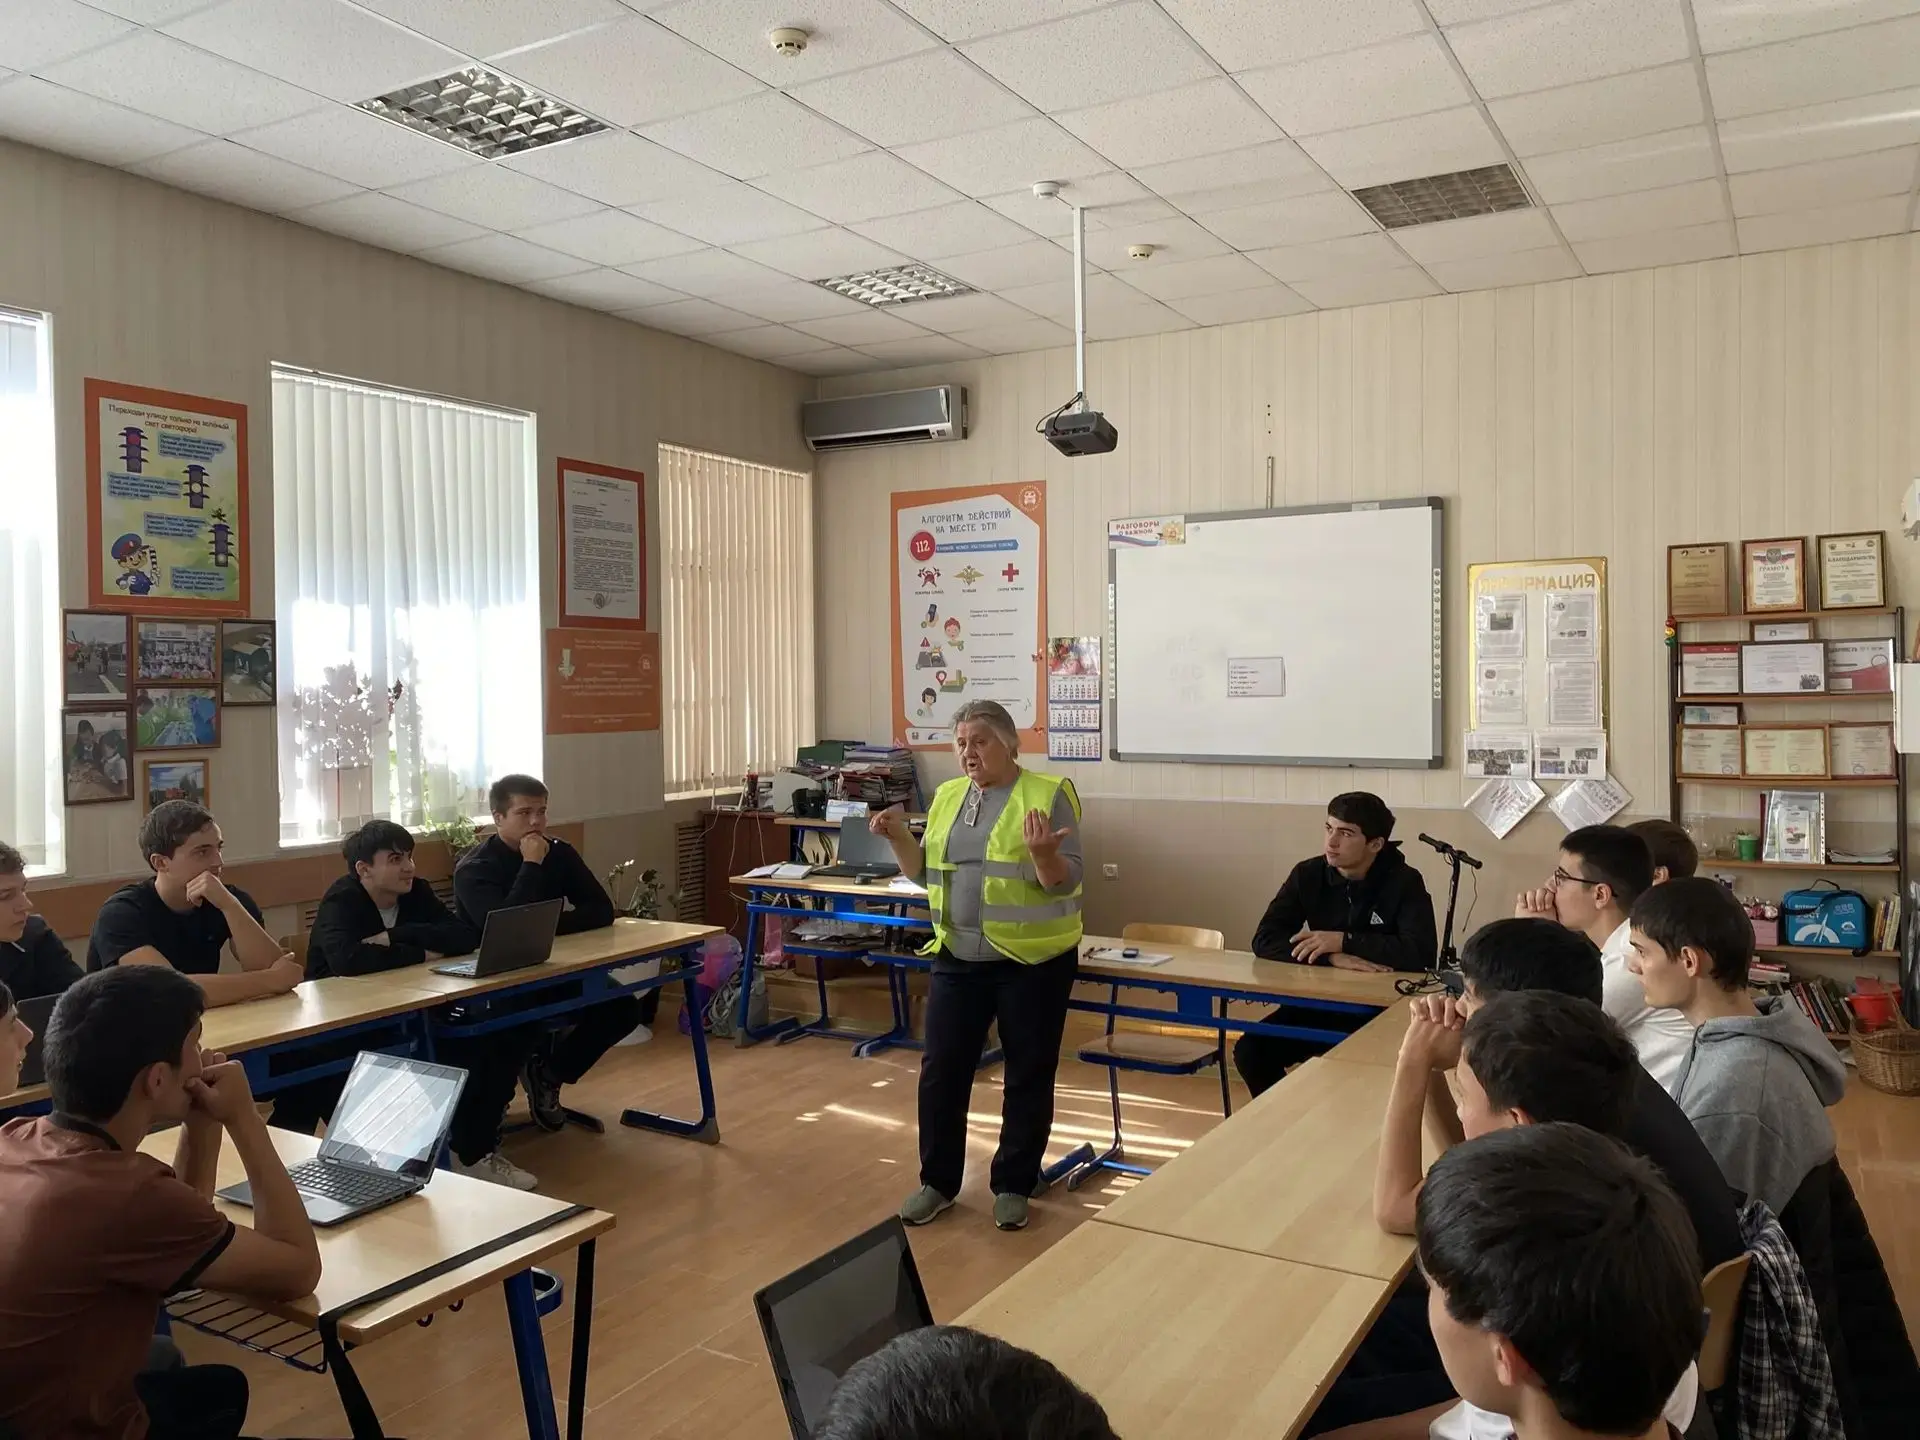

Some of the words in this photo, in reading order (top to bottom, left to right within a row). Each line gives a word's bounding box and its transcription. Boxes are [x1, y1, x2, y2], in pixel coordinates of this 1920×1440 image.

[109, 404, 145, 417] Переходи
[146, 411, 168, 422] улицу
[169, 415, 192, 424] только
[145, 420, 159, 428] свет
[921, 513, 964, 524] АЛГОРИТМ
[968, 508, 1011, 520] ДЕЙСТВИЙ
[935, 526, 945, 534] НА
[949, 524, 977, 534] МЕСТЕ
[981, 522, 997, 532] ДТП
[1116, 521, 1160, 530] РАЗГОВОРЫ
[915, 539, 931, 554] 112
[1758, 565, 1790, 573] ГРАМОТА
[1480, 574, 1595, 591] ИНФРМАЦИЯ
